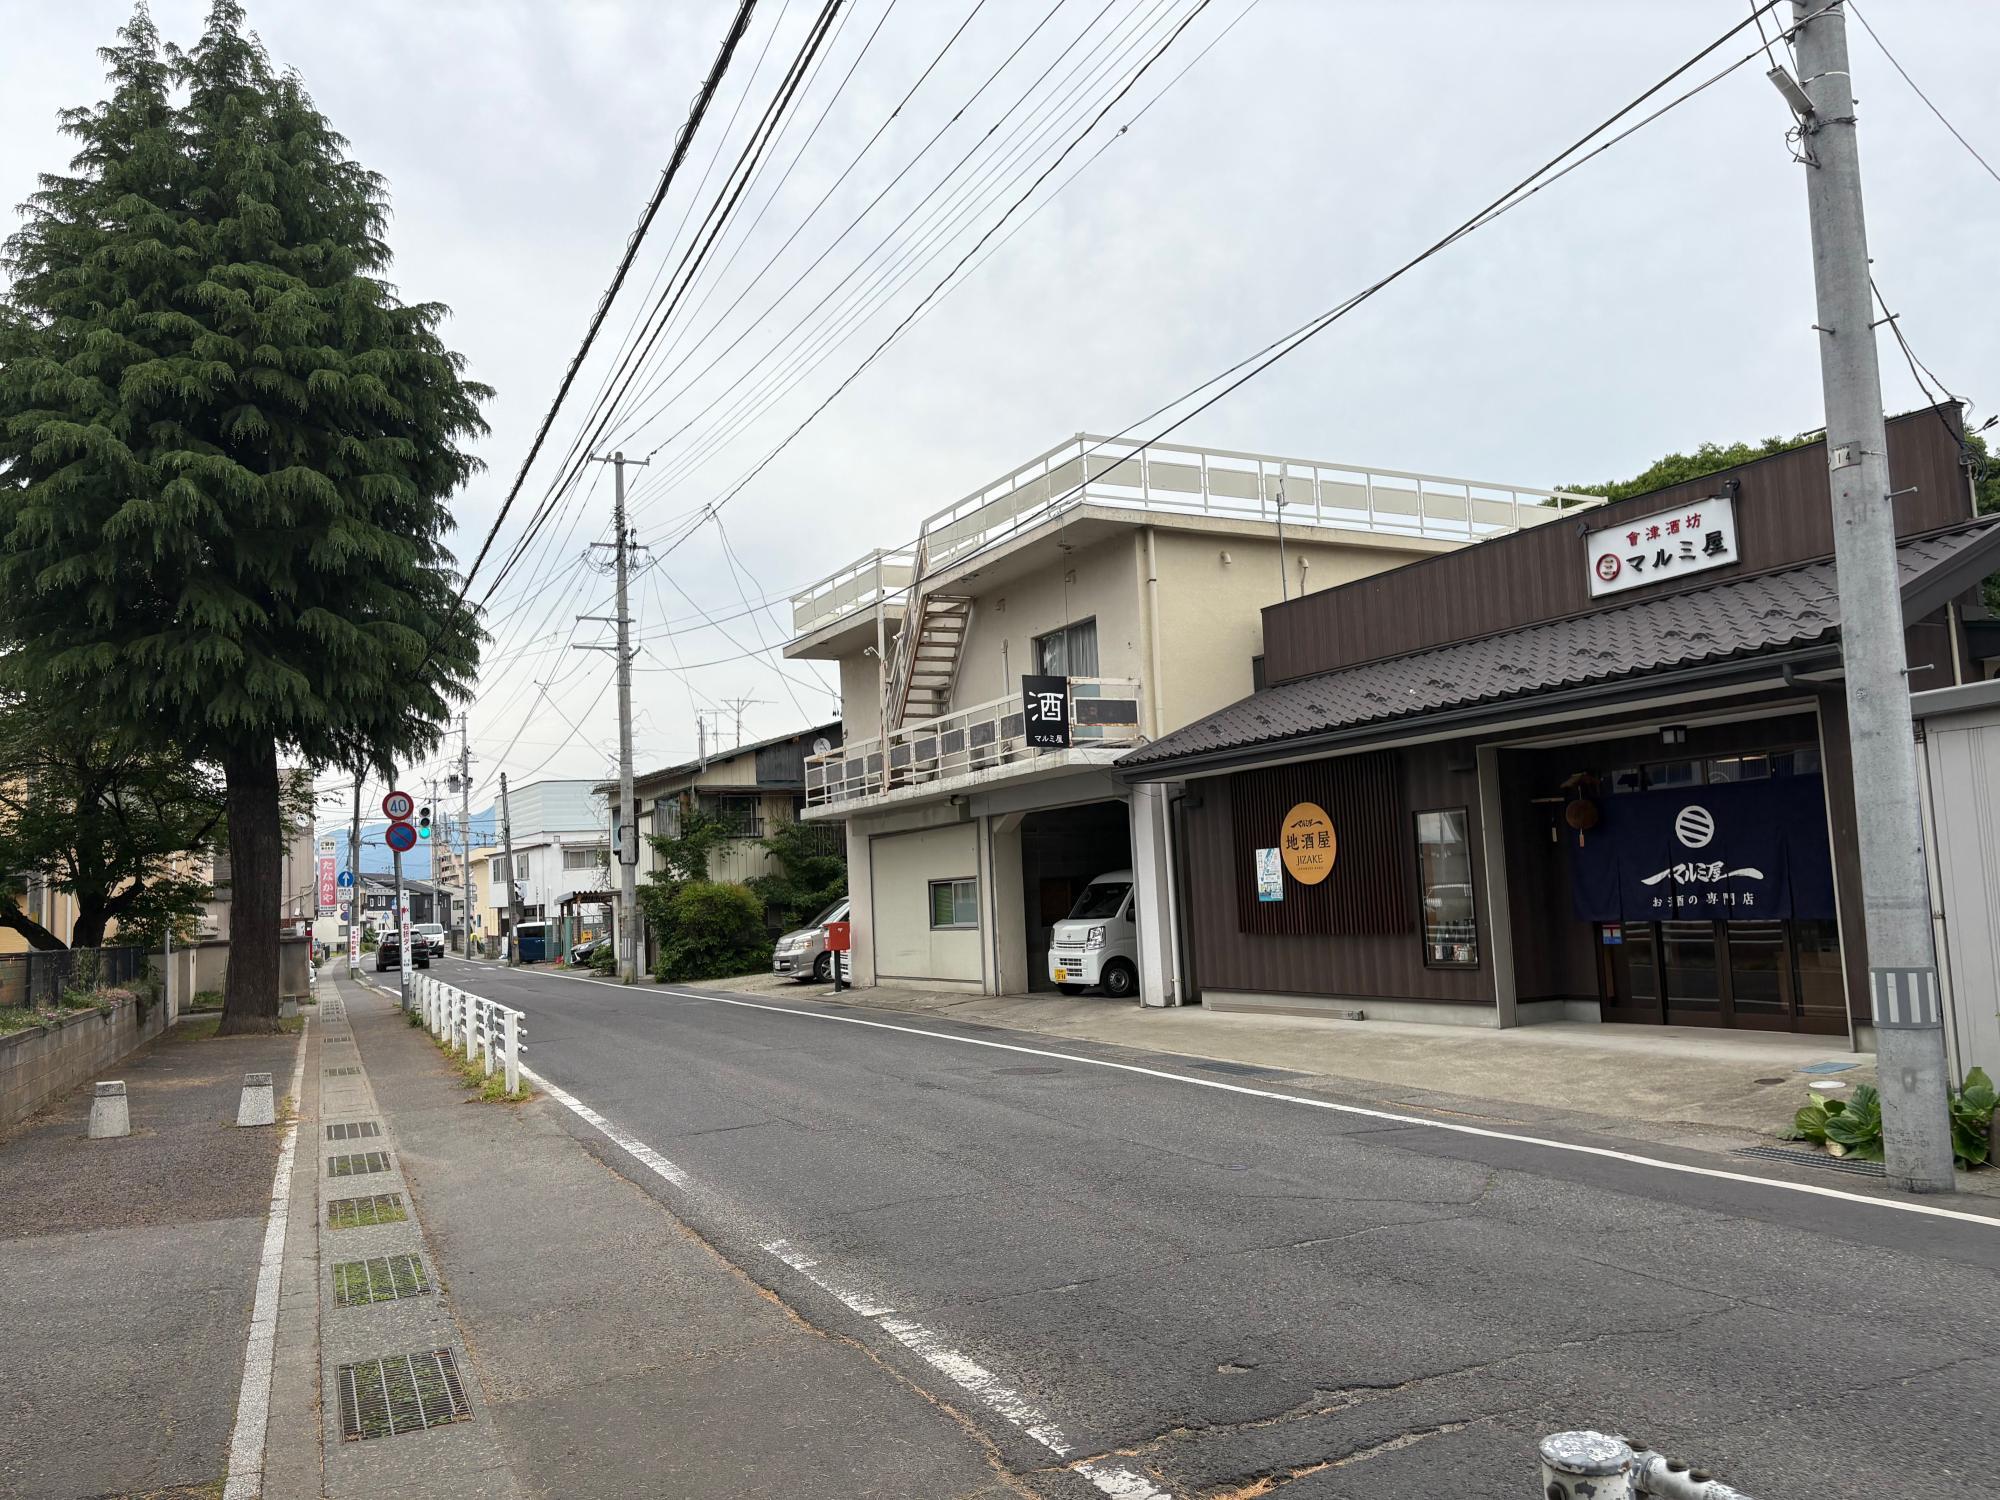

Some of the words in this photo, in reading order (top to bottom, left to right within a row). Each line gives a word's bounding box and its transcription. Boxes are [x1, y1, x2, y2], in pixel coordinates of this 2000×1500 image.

[1626, 512, 1702, 546] 會津酒坊
[1027, 691, 1064, 721] 酒
[1034, 734, 1064, 744] マルミ屋
[390, 799, 407, 813] 40
[1286, 830, 1331, 850] 地酒屋
[1296, 854, 1324, 866] JIZAKE
[322, 860, 334, 904] たなかや
